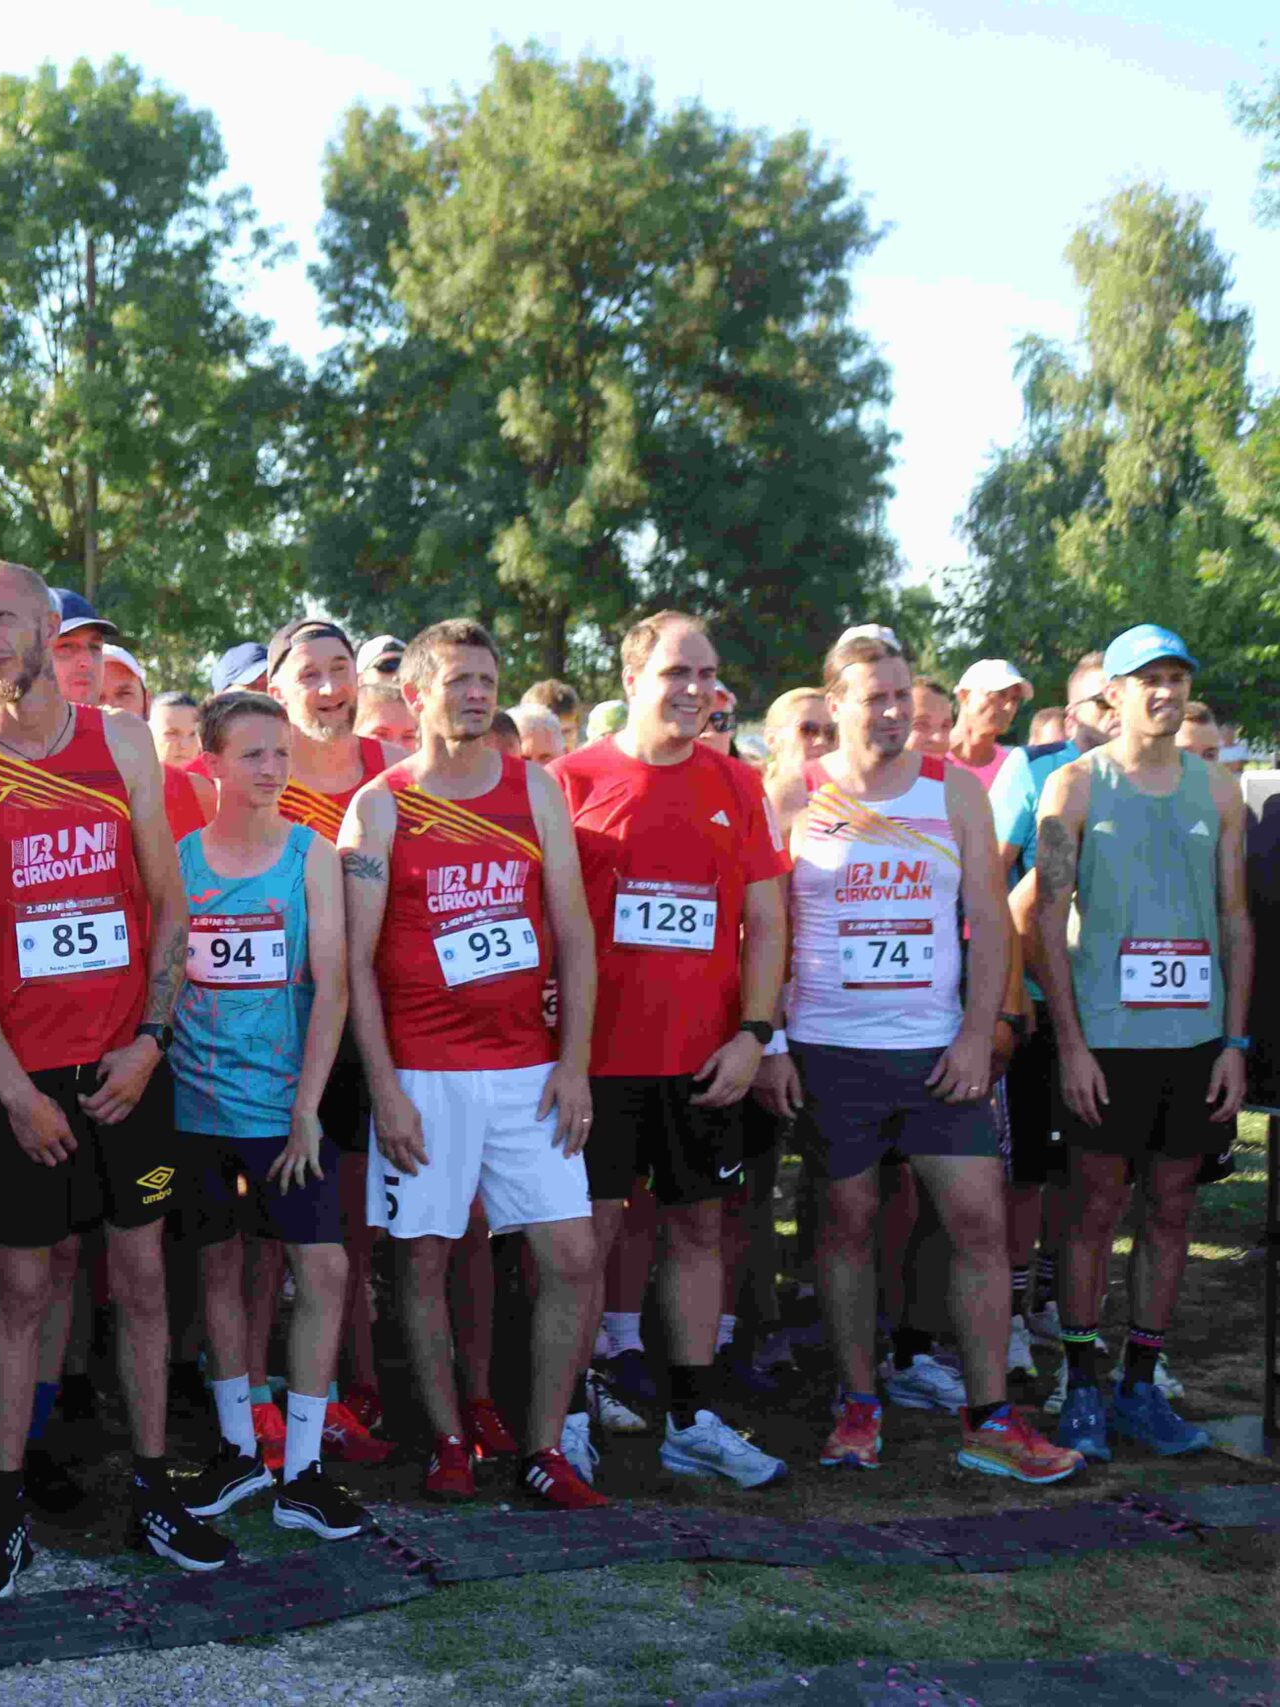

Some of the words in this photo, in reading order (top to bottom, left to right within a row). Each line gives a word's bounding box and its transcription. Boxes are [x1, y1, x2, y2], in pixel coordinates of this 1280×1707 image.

[28, 822, 104, 866] RUN
[12, 850, 116, 889] CIRKOVLJAN
[442, 860, 516, 892] RUN
[427, 885, 524, 913] CIRKOVLJAN
[834, 884, 932, 904] CIRKOVLJAN
[636, 902, 696, 933] 128
[52, 922, 98, 957] 85
[210, 938, 256, 968] 94
[468, 928, 512, 962] 93
[868, 941, 910, 968] 74
[1150, 960, 1186, 988] 30
